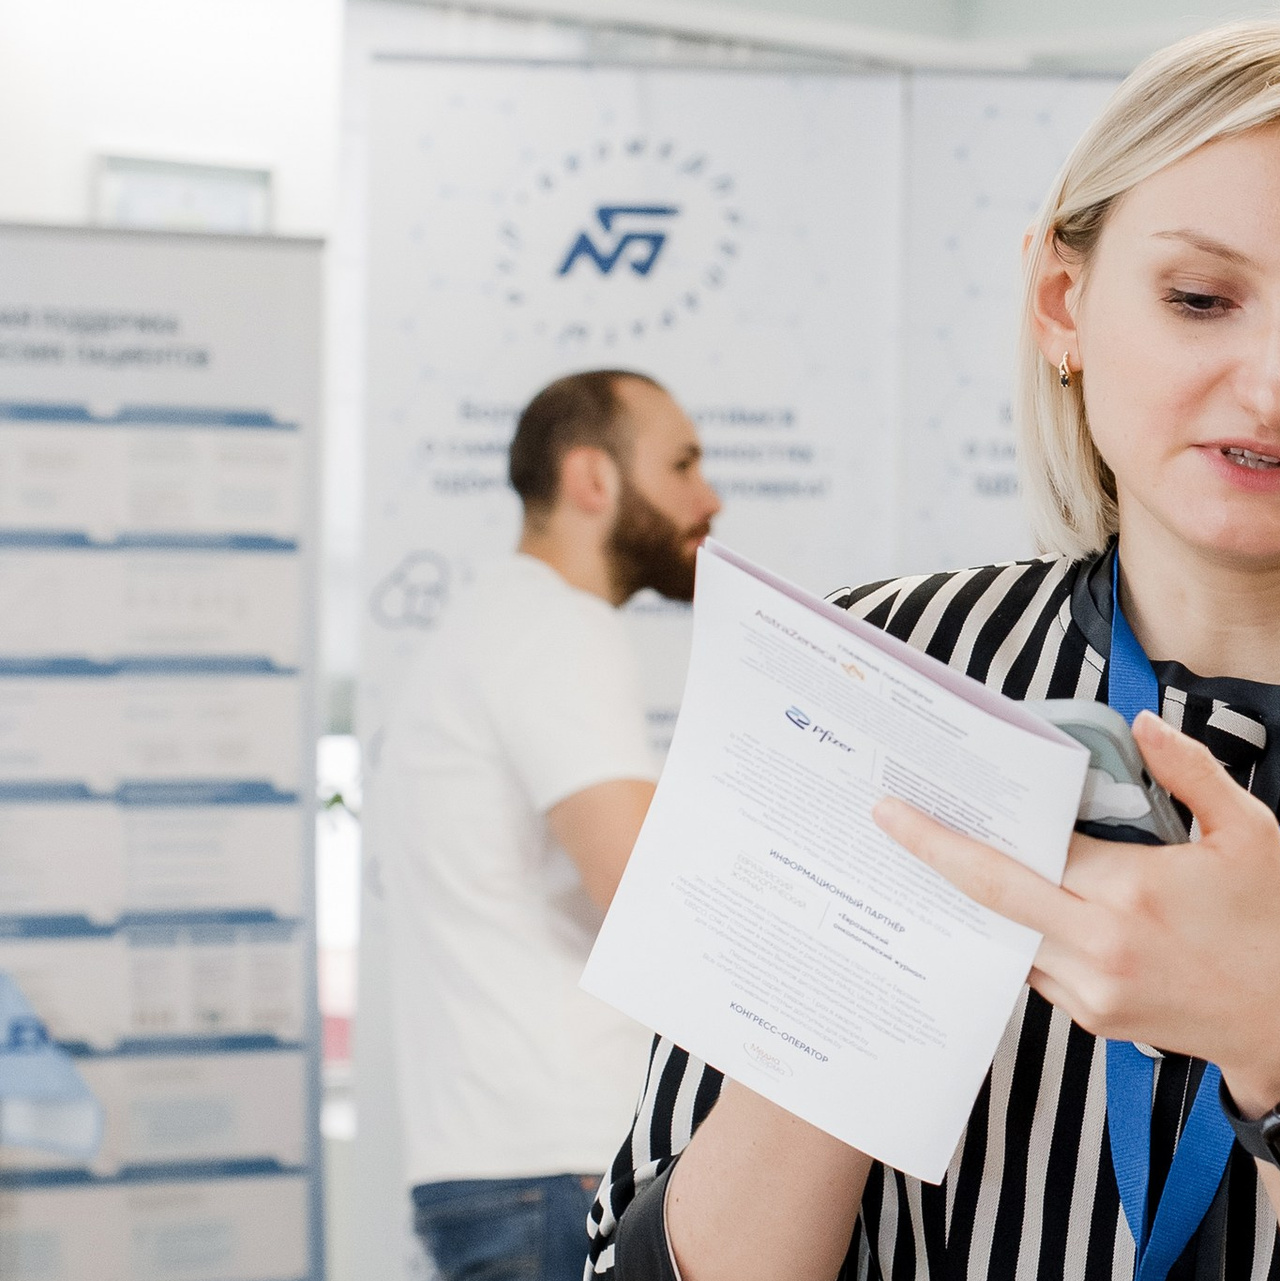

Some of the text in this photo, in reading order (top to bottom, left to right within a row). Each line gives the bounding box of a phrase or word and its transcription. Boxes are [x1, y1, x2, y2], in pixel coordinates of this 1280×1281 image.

[754, 608, 838, 664] AstraZeneca
[809, 723, 858, 759] Pfizer
[732, 861, 807, 910] ОНКОЛОГИЧЕСКИЙ
[735, 852, 794, 892] ЕВРАЗИЙСКИЙ
[768, 847, 864, 909] ИНФОРМАЦИОННЫЙ
[863, 904, 907, 935] ПАРТНЁР
[832, 922, 893, 962] онкологический
[728, 1000, 829, 1064] КОНГРЕСС-ОПЕРАТОР
